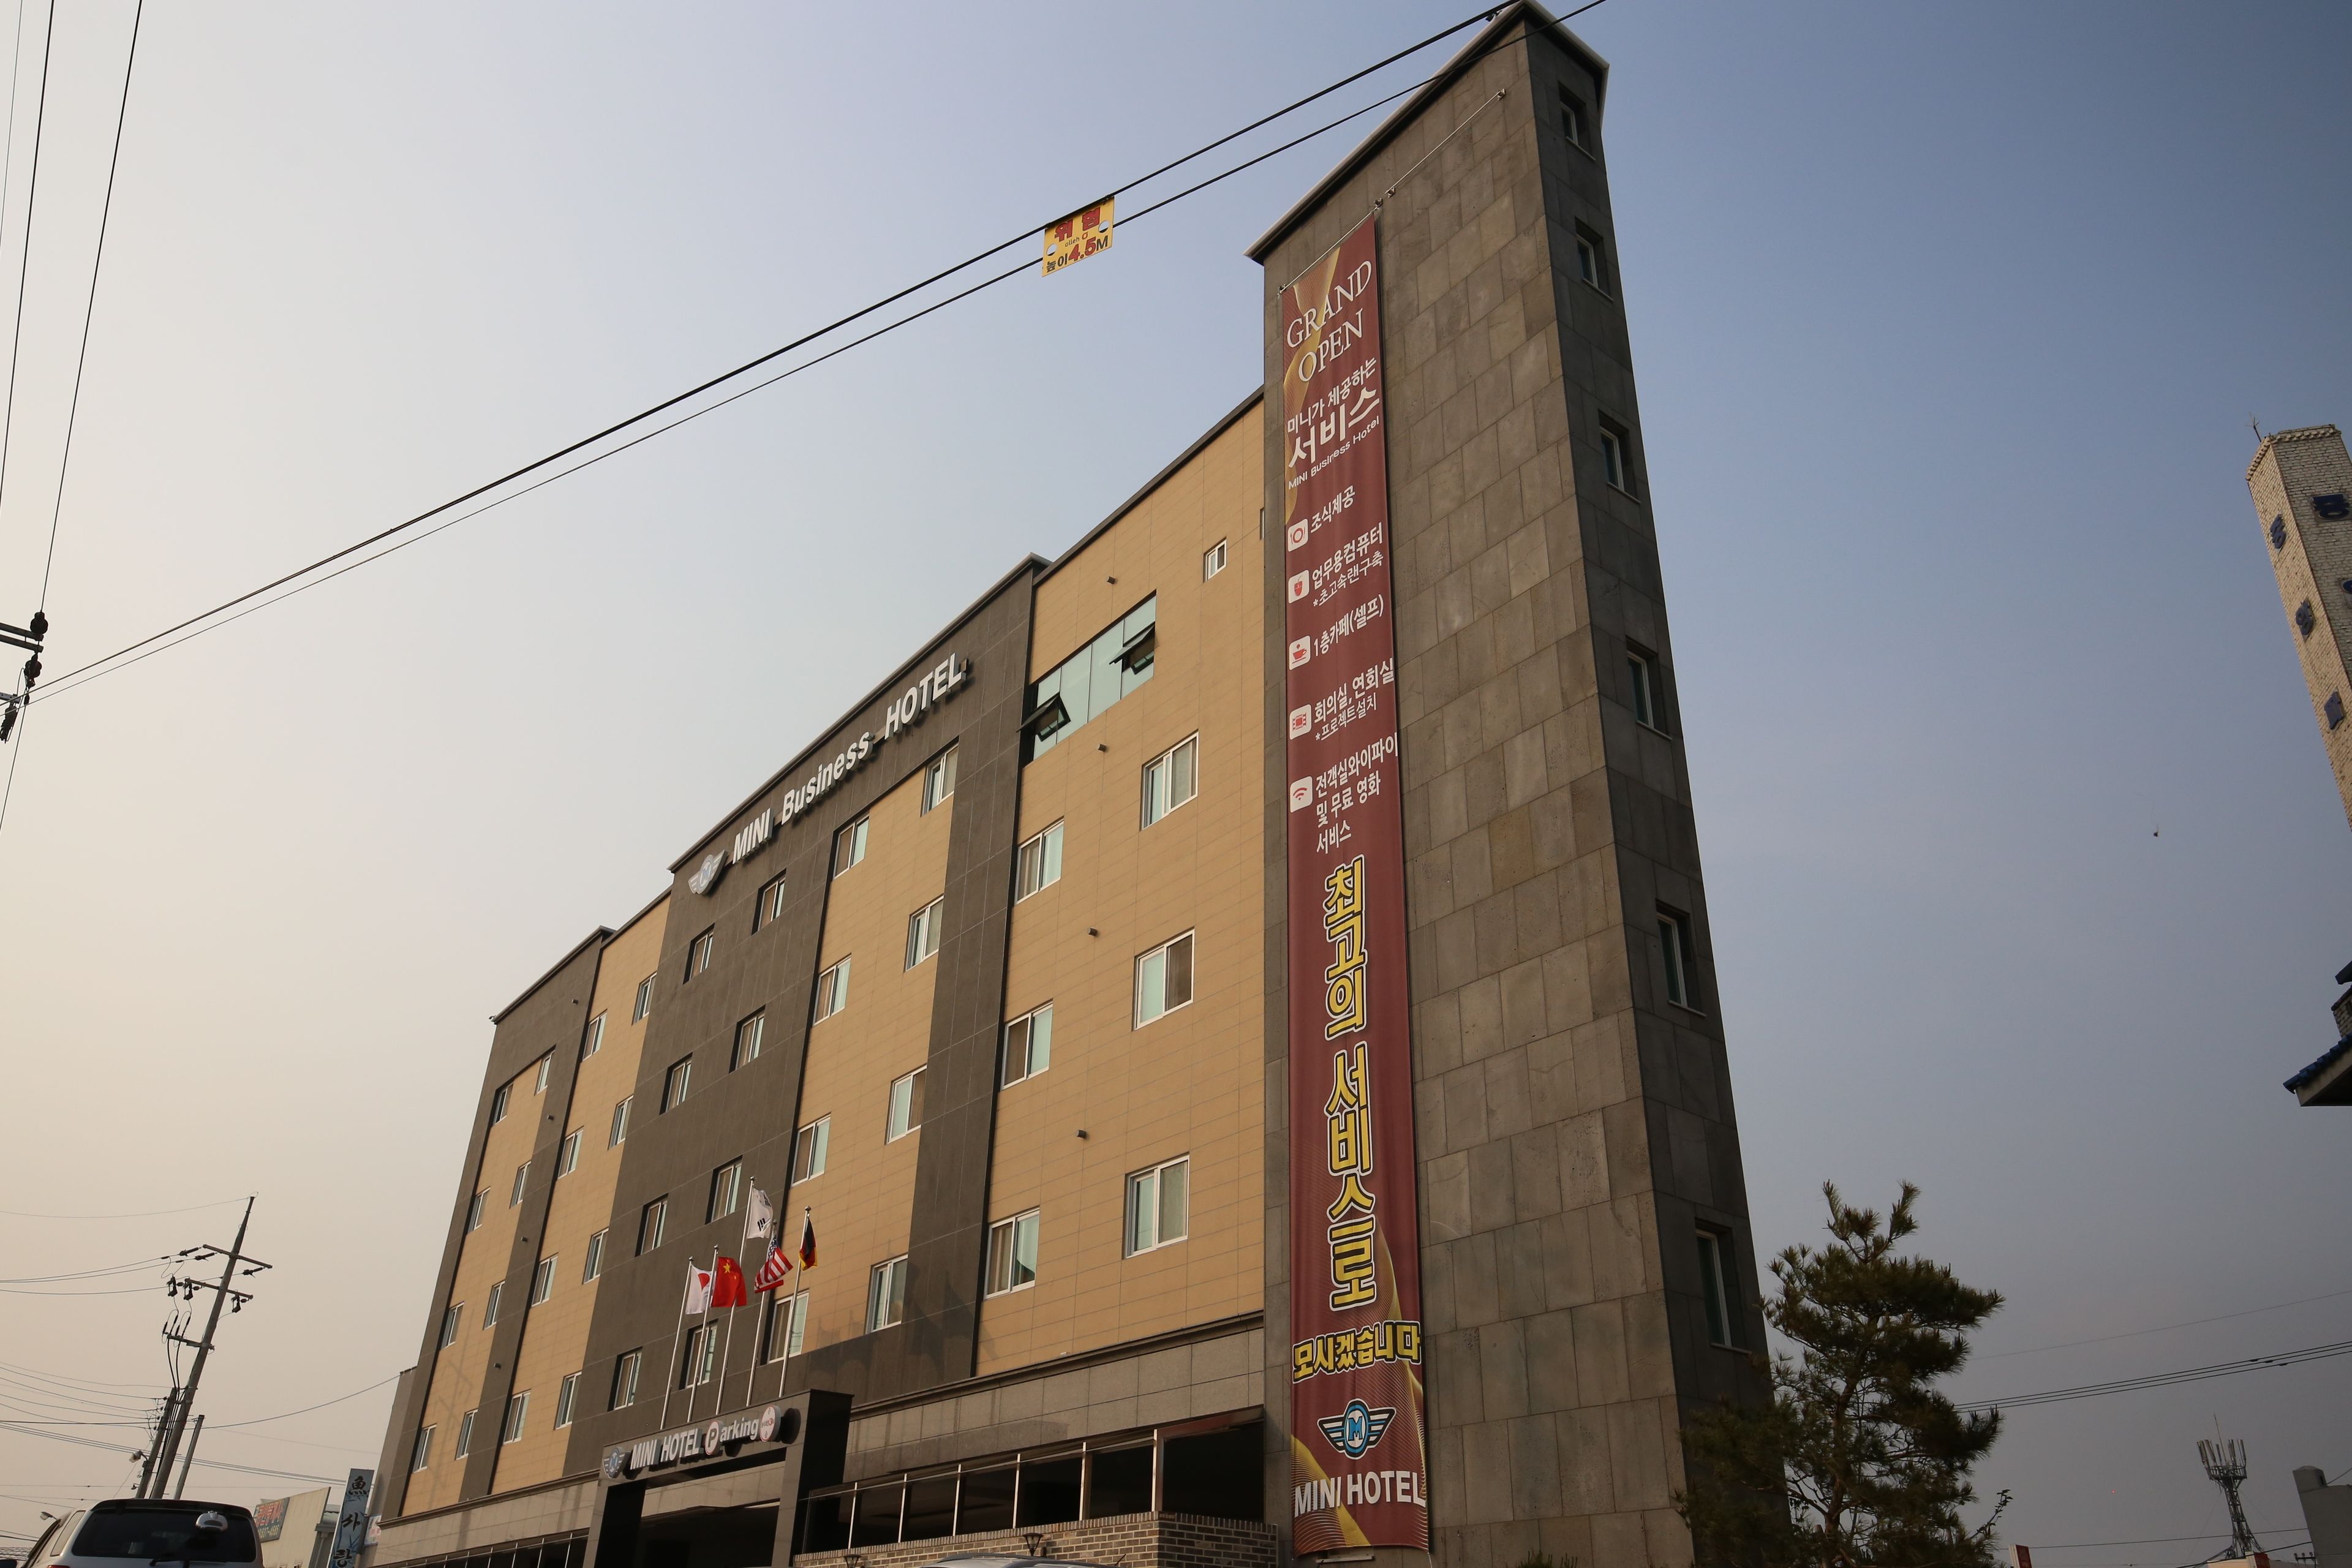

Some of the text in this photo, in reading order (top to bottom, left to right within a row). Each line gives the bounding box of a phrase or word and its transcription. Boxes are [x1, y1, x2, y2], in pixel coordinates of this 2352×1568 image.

[1286, 260, 1373, 349] GRAND
[1298, 309, 1363, 383] OPEN
[1287, 357, 1377, 434] 미니가 제공하는
[1288, 386, 1380, 469] 서비스
[1289, 415, 1379, 490] MINI Business Hotel
[1310, 485, 1355, 534] 조식제공
[1312, 522, 1383, 590] 업무용컴퓨터
[1352, 657, 1395, 699] 연회실
[733, 807, 773, 865] MINI
[782, 731, 873, 825] Business
[884, 652, 965, 741] HOTEL
[1316, 731, 1398, 799] 전객실와이파이
[1331, 787, 1354, 818] 무료
[1357, 770, 1381, 804] 영화
[1316, 820, 1352, 854] 서비스
[1322, 854, 1377, 1312] 최고의 서비스로
[1292, 1320, 1422, 1384] 모시겠습니다
[630, 1439, 658, 1470] MINI
[660, 1428, 700, 1463] HOTEL
[1294, 1470, 1427, 1518] MINI HOTEL
